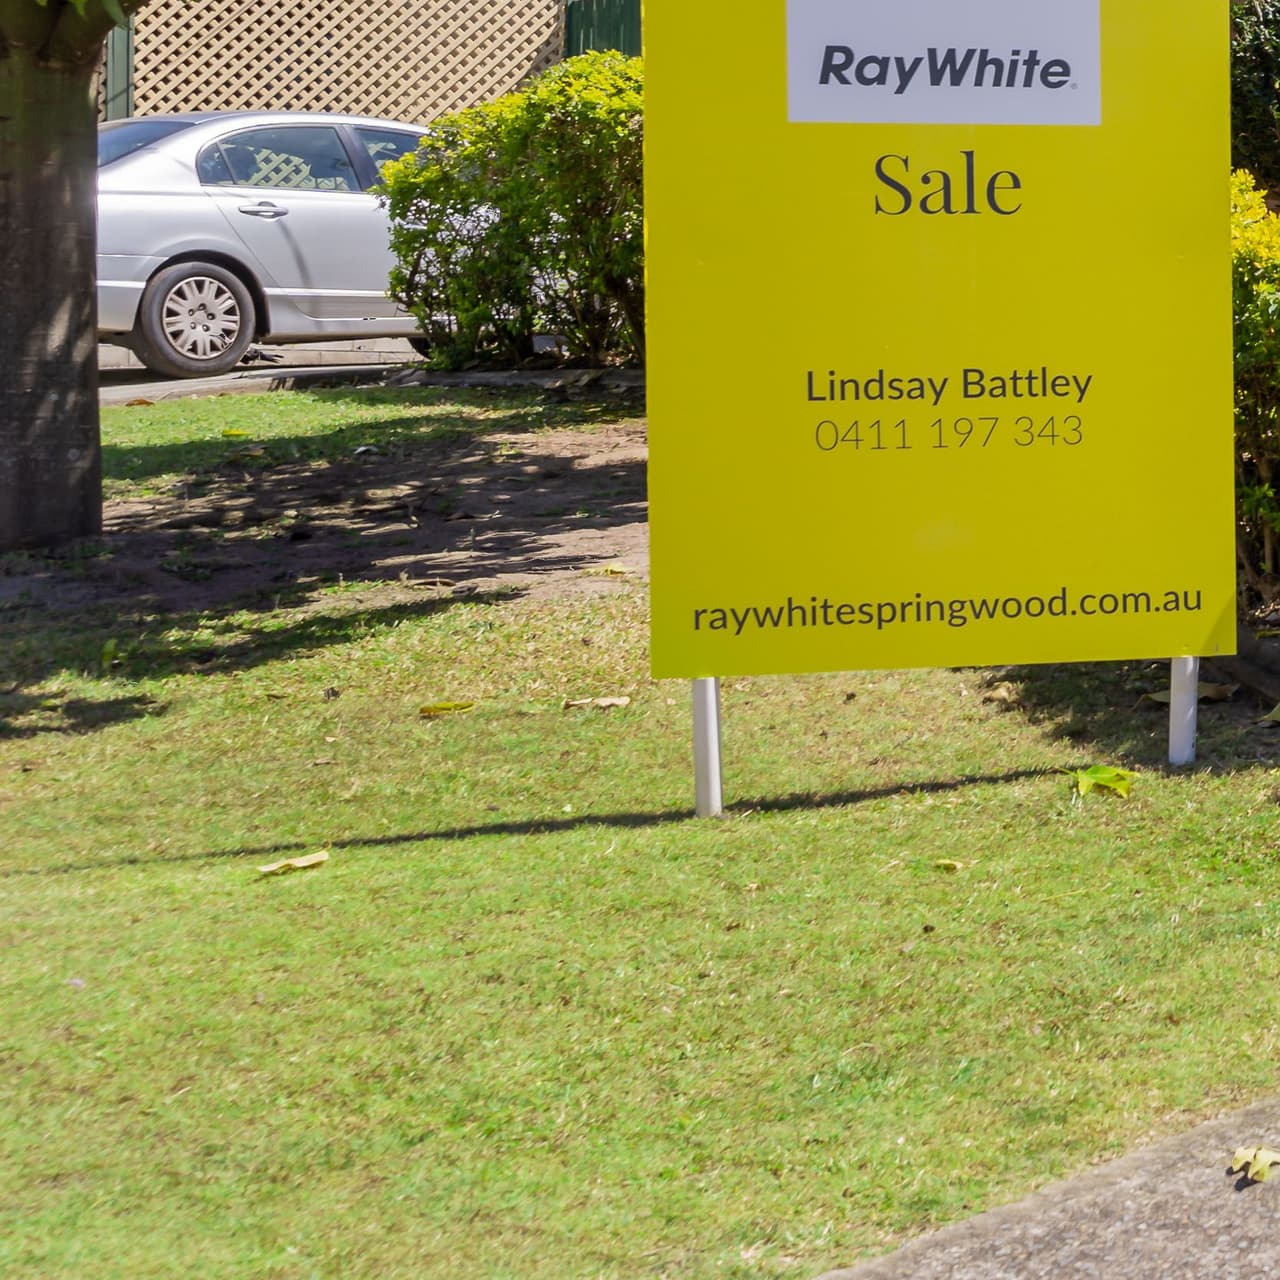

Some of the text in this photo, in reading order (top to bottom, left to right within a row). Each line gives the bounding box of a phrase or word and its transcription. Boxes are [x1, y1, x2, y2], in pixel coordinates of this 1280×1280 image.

[874, 149, 1022, 216] Sale
[807, 366, 1093, 407] Lindsay Battley
[815, 414, 1083, 452] 0411 197 343
[693, 586, 1202, 637] raywhitespringwood.com.au
